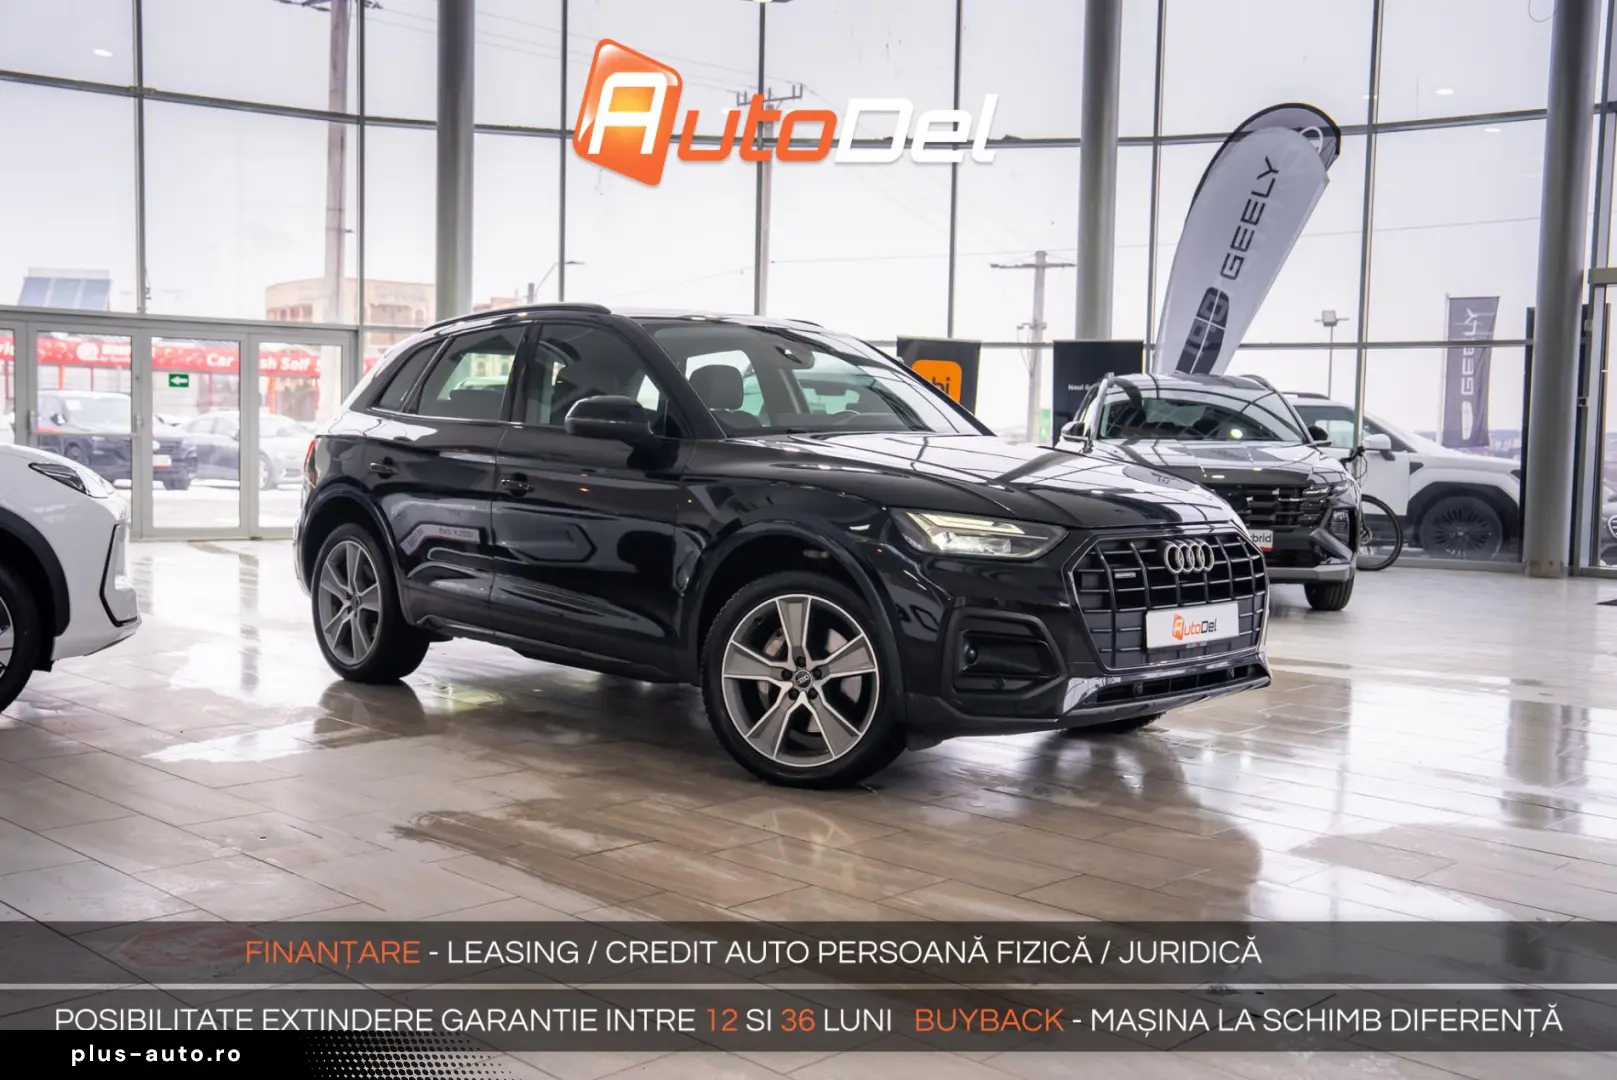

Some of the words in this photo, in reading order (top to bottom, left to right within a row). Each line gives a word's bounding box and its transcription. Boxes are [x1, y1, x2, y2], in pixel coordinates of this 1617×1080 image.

[1220, 156, 1279, 280] GEELY
[1460, 307, 1479, 395] GEELY
[206, 353, 235, 368] Car
[259, 355, 277, 370] sh
[280, 357, 311, 371] Self
[1250, 532, 1272, 543] brid
[1173, 617, 1218, 637] AutoDel
